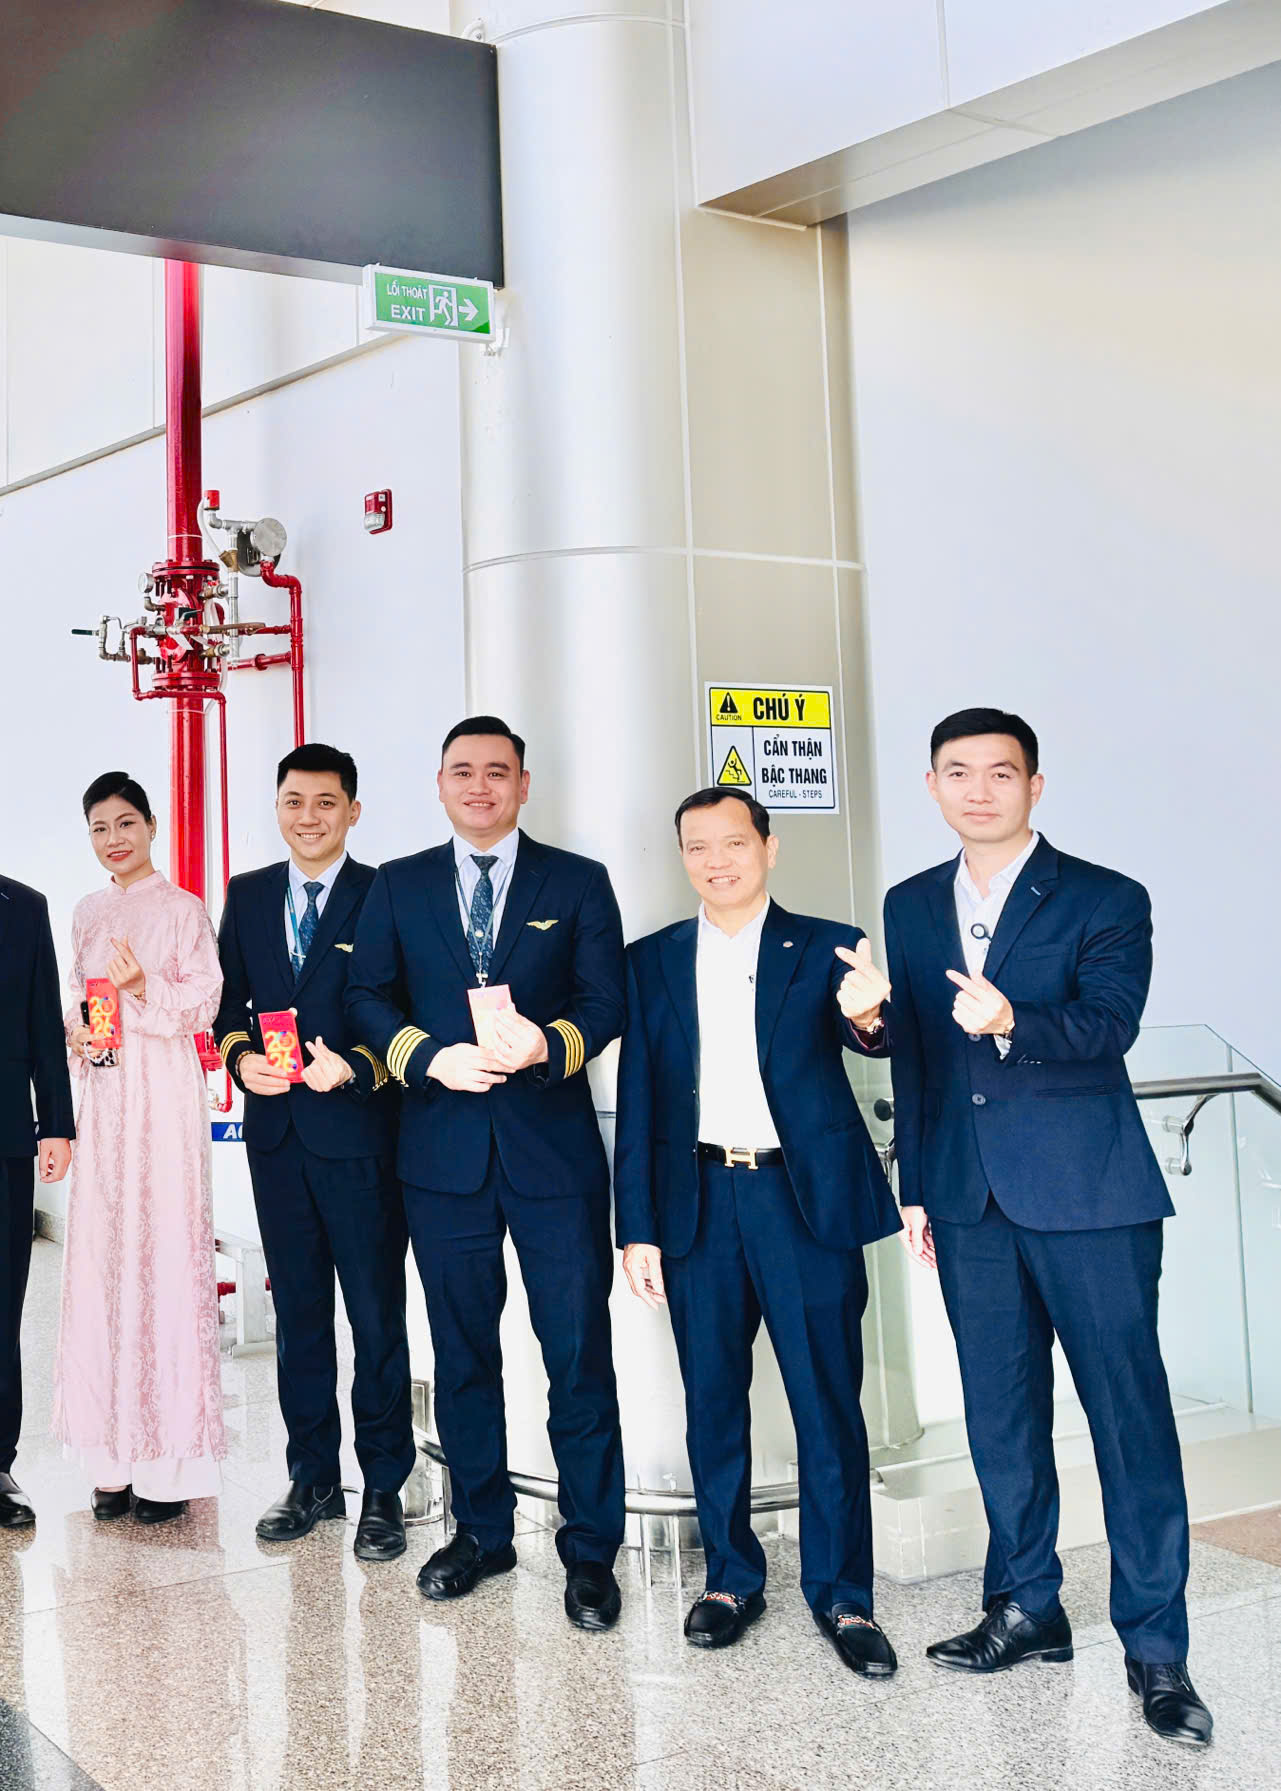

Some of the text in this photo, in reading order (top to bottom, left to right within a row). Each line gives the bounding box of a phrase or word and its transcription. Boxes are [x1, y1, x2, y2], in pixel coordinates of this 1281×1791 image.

[402, 285, 427, 300] THOÁT
[391, 304, 425, 321] EXIT
[753, 693, 806, 721] CHÚ Ý
[763, 733, 822, 760] CẨN THẬN
[761, 764, 827, 787] BẬC THANG
[768, 790, 797, 799] CAREFUL
[802, 790, 823, 799] STEPS
[89, 996, 115, 1017] 20
[264, 1030, 296, 1053] 20
